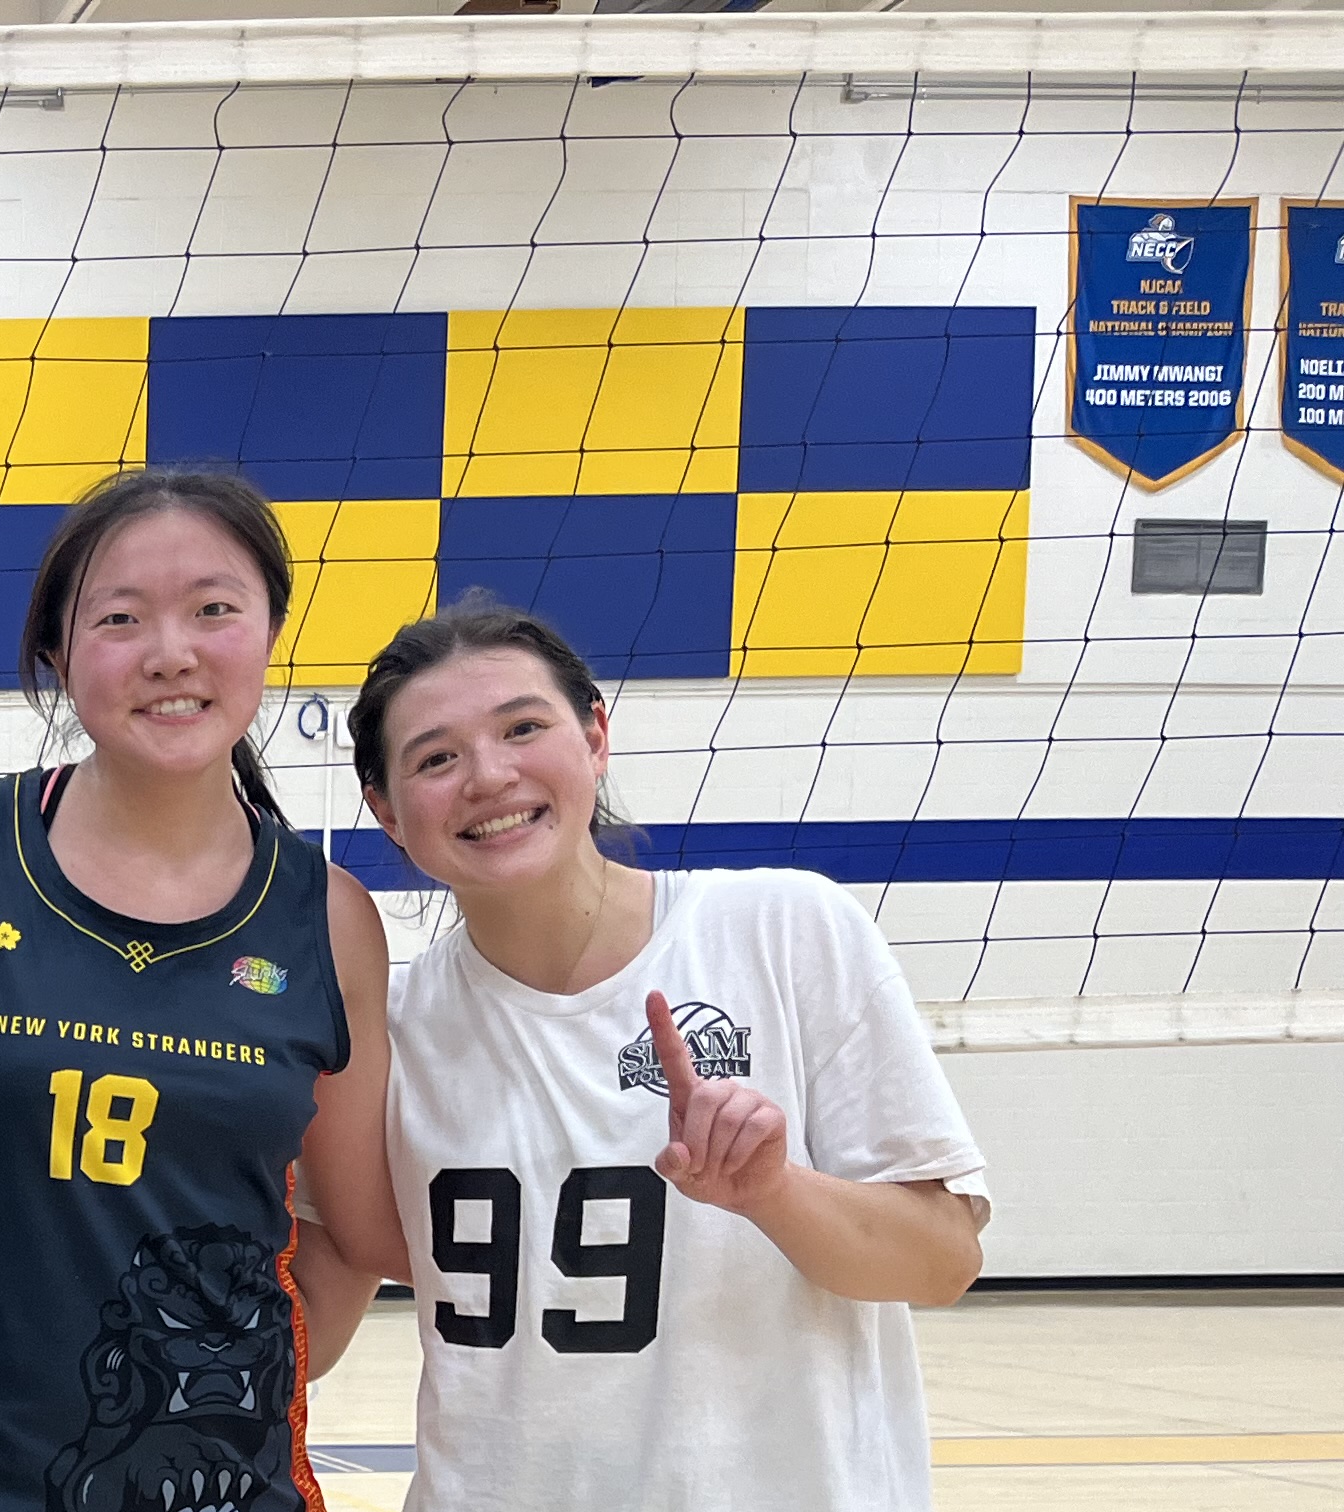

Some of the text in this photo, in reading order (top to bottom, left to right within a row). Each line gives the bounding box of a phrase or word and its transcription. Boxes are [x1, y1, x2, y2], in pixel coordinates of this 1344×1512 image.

[1130, 242, 1177, 258] NECC
[1140, 279, 1184, 294] NJCAA
[1111, 300, 1156, 315] TRACK
[1172, 301, 1210, 315] FIELD
[1089, 320, 1155, 336] NATIONAL
[1093, 364, 1223, 383] JIMMY MWANGI
[1085, 388, 1232, 407] 400 METERS 2006
[1298, 383, 1326, 400] 200
[1298, 407, 1325, 424] 100
[57, 1020, 121, 1045] YORK
[131, 1031, 265, 1066] STRANGERS
[626, 1062, 743, 1085] VOLBALL
[48, 1069, 159, 1187] 18
[429, 1165, 667, 1354] 99
